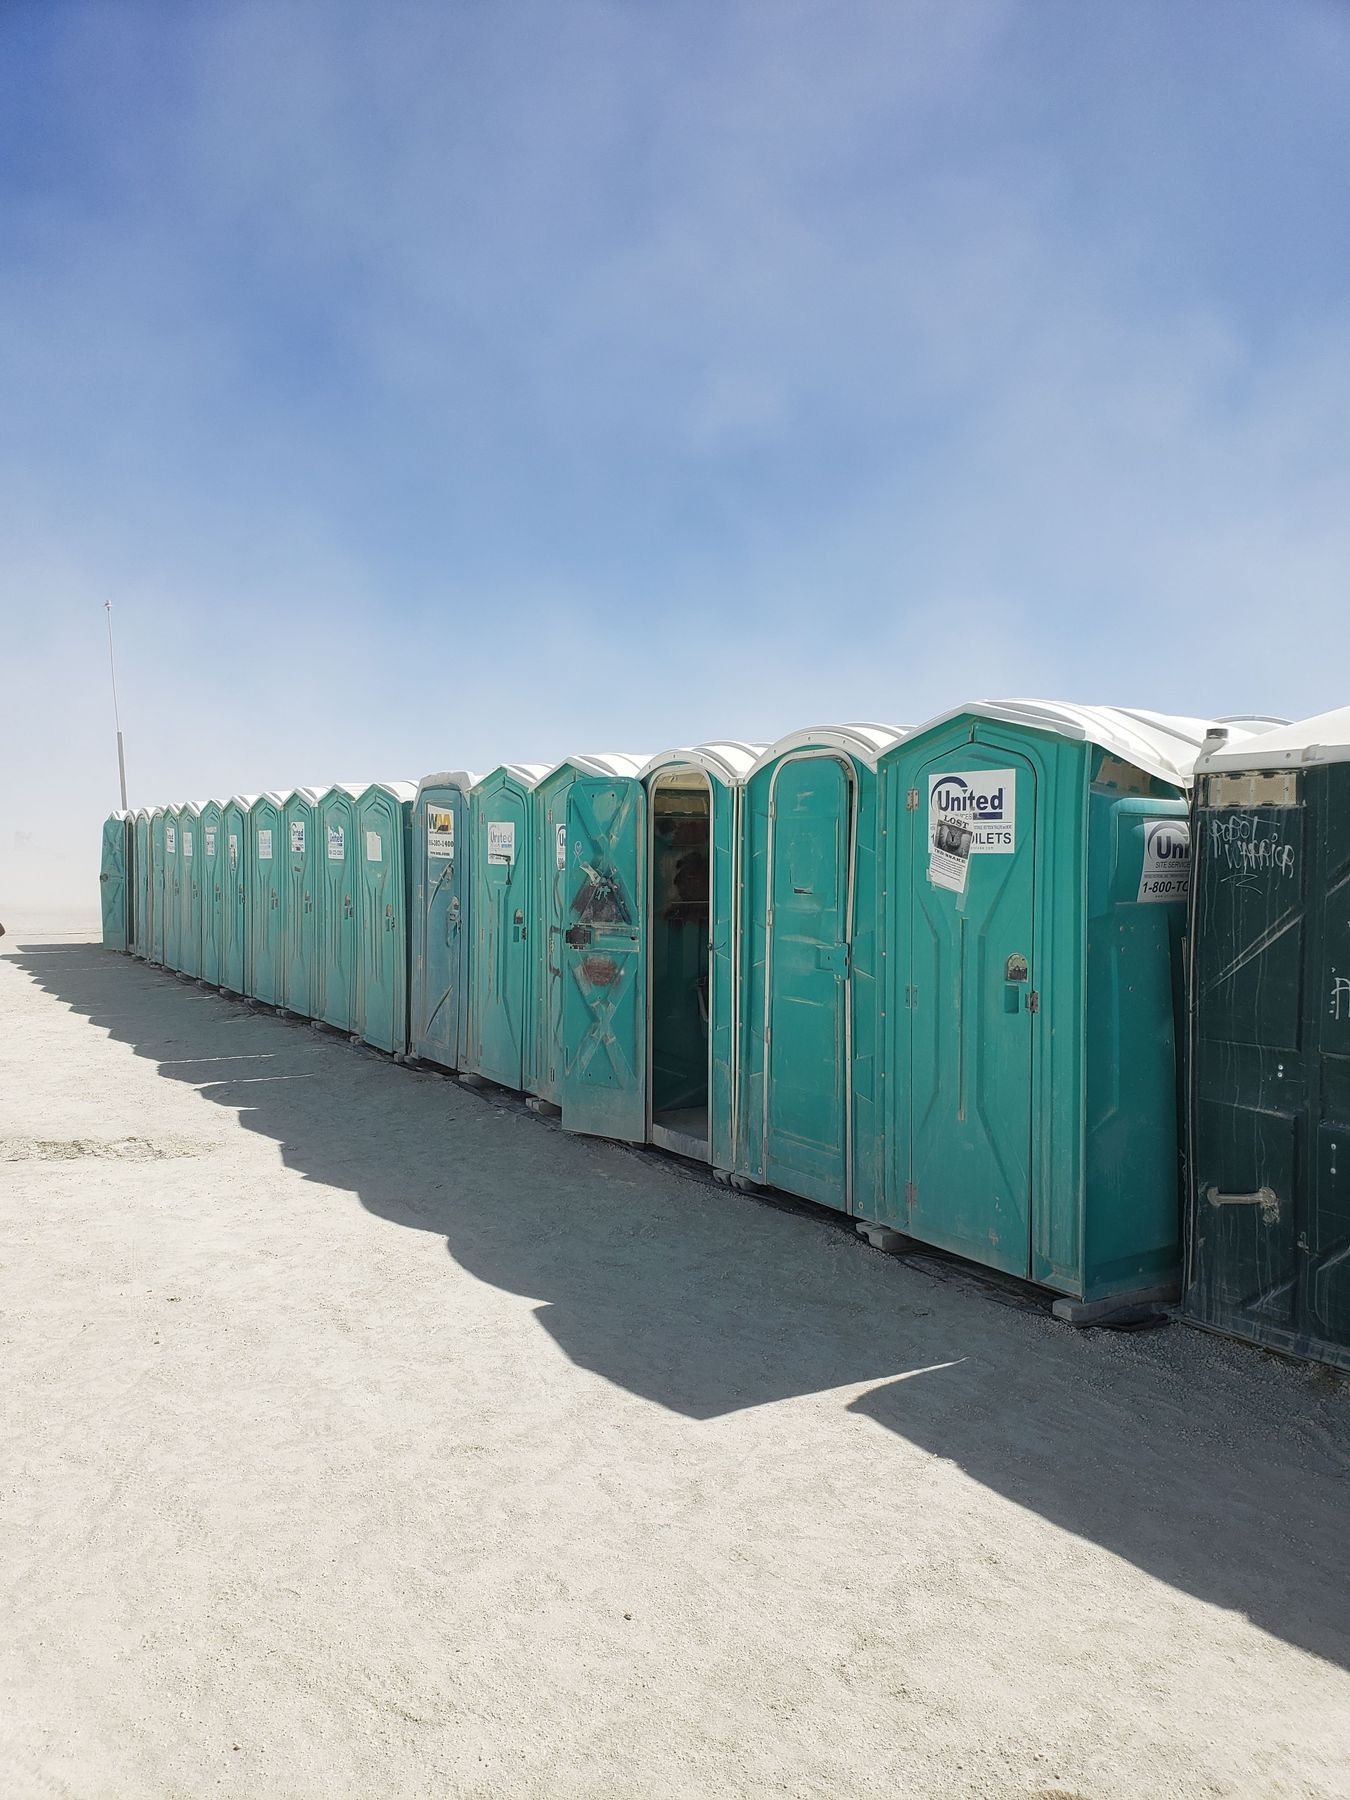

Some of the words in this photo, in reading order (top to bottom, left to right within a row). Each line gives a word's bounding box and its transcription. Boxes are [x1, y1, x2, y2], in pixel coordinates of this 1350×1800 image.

[938, 787, 1003, 812] United
[943, 815, 969, 829] LOST
[1155, 861, 1168, 869] SITE
